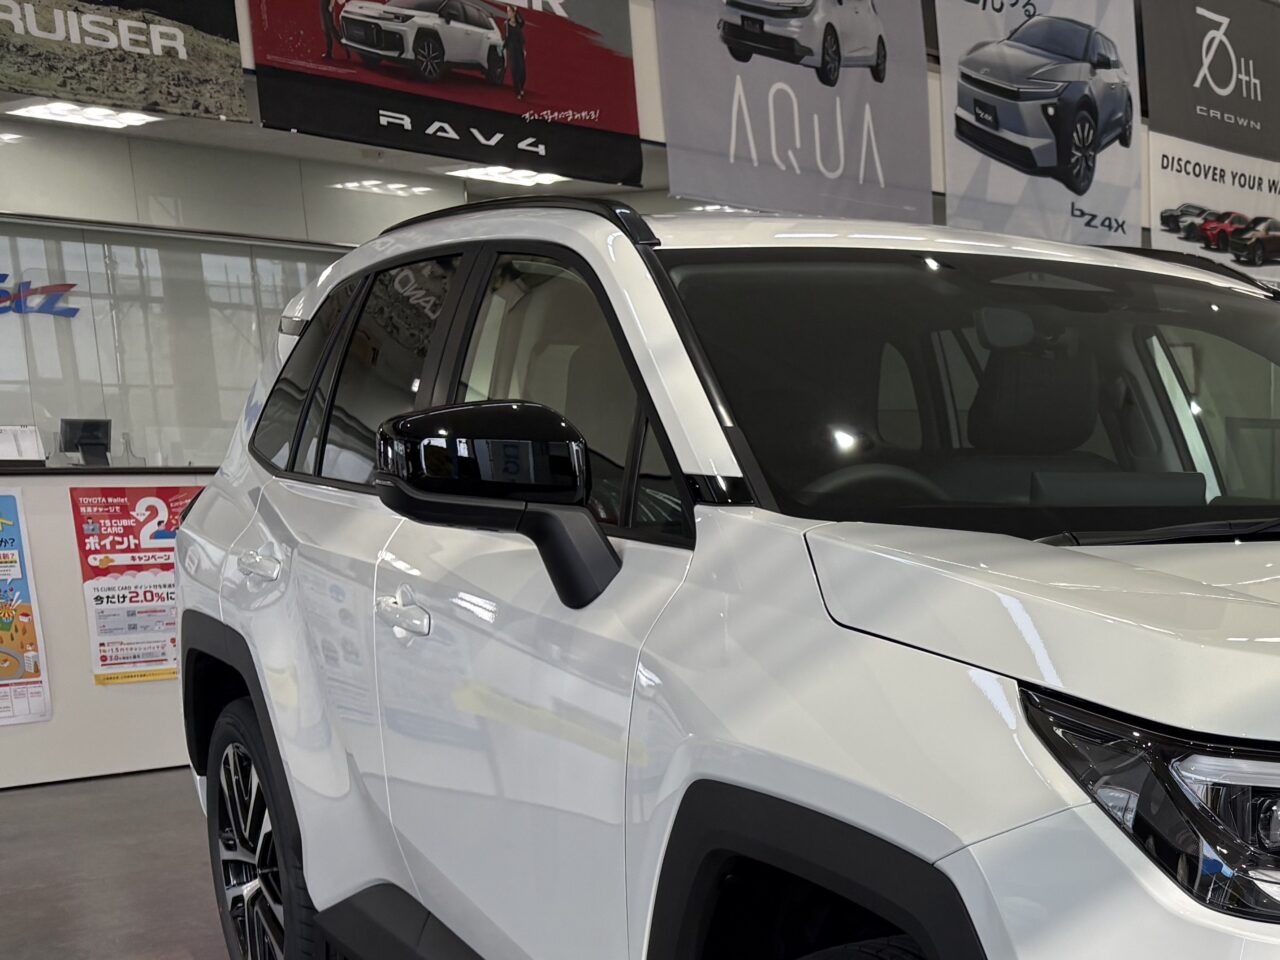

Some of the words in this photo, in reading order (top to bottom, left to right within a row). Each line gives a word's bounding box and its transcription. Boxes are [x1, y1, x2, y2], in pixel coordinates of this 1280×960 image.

[1193, 6, 1261, 101] 70th
[378, 109, 546, 156] RAV4
[730, 75, 885, 188] AQUA
[1196, 105, 1261, 130] CROWN
[1161, 154, 1226, 184] DISCOVER
[1231, 170, 1263, 192] YOUR
[85, 535, 139, 550] ポイント
